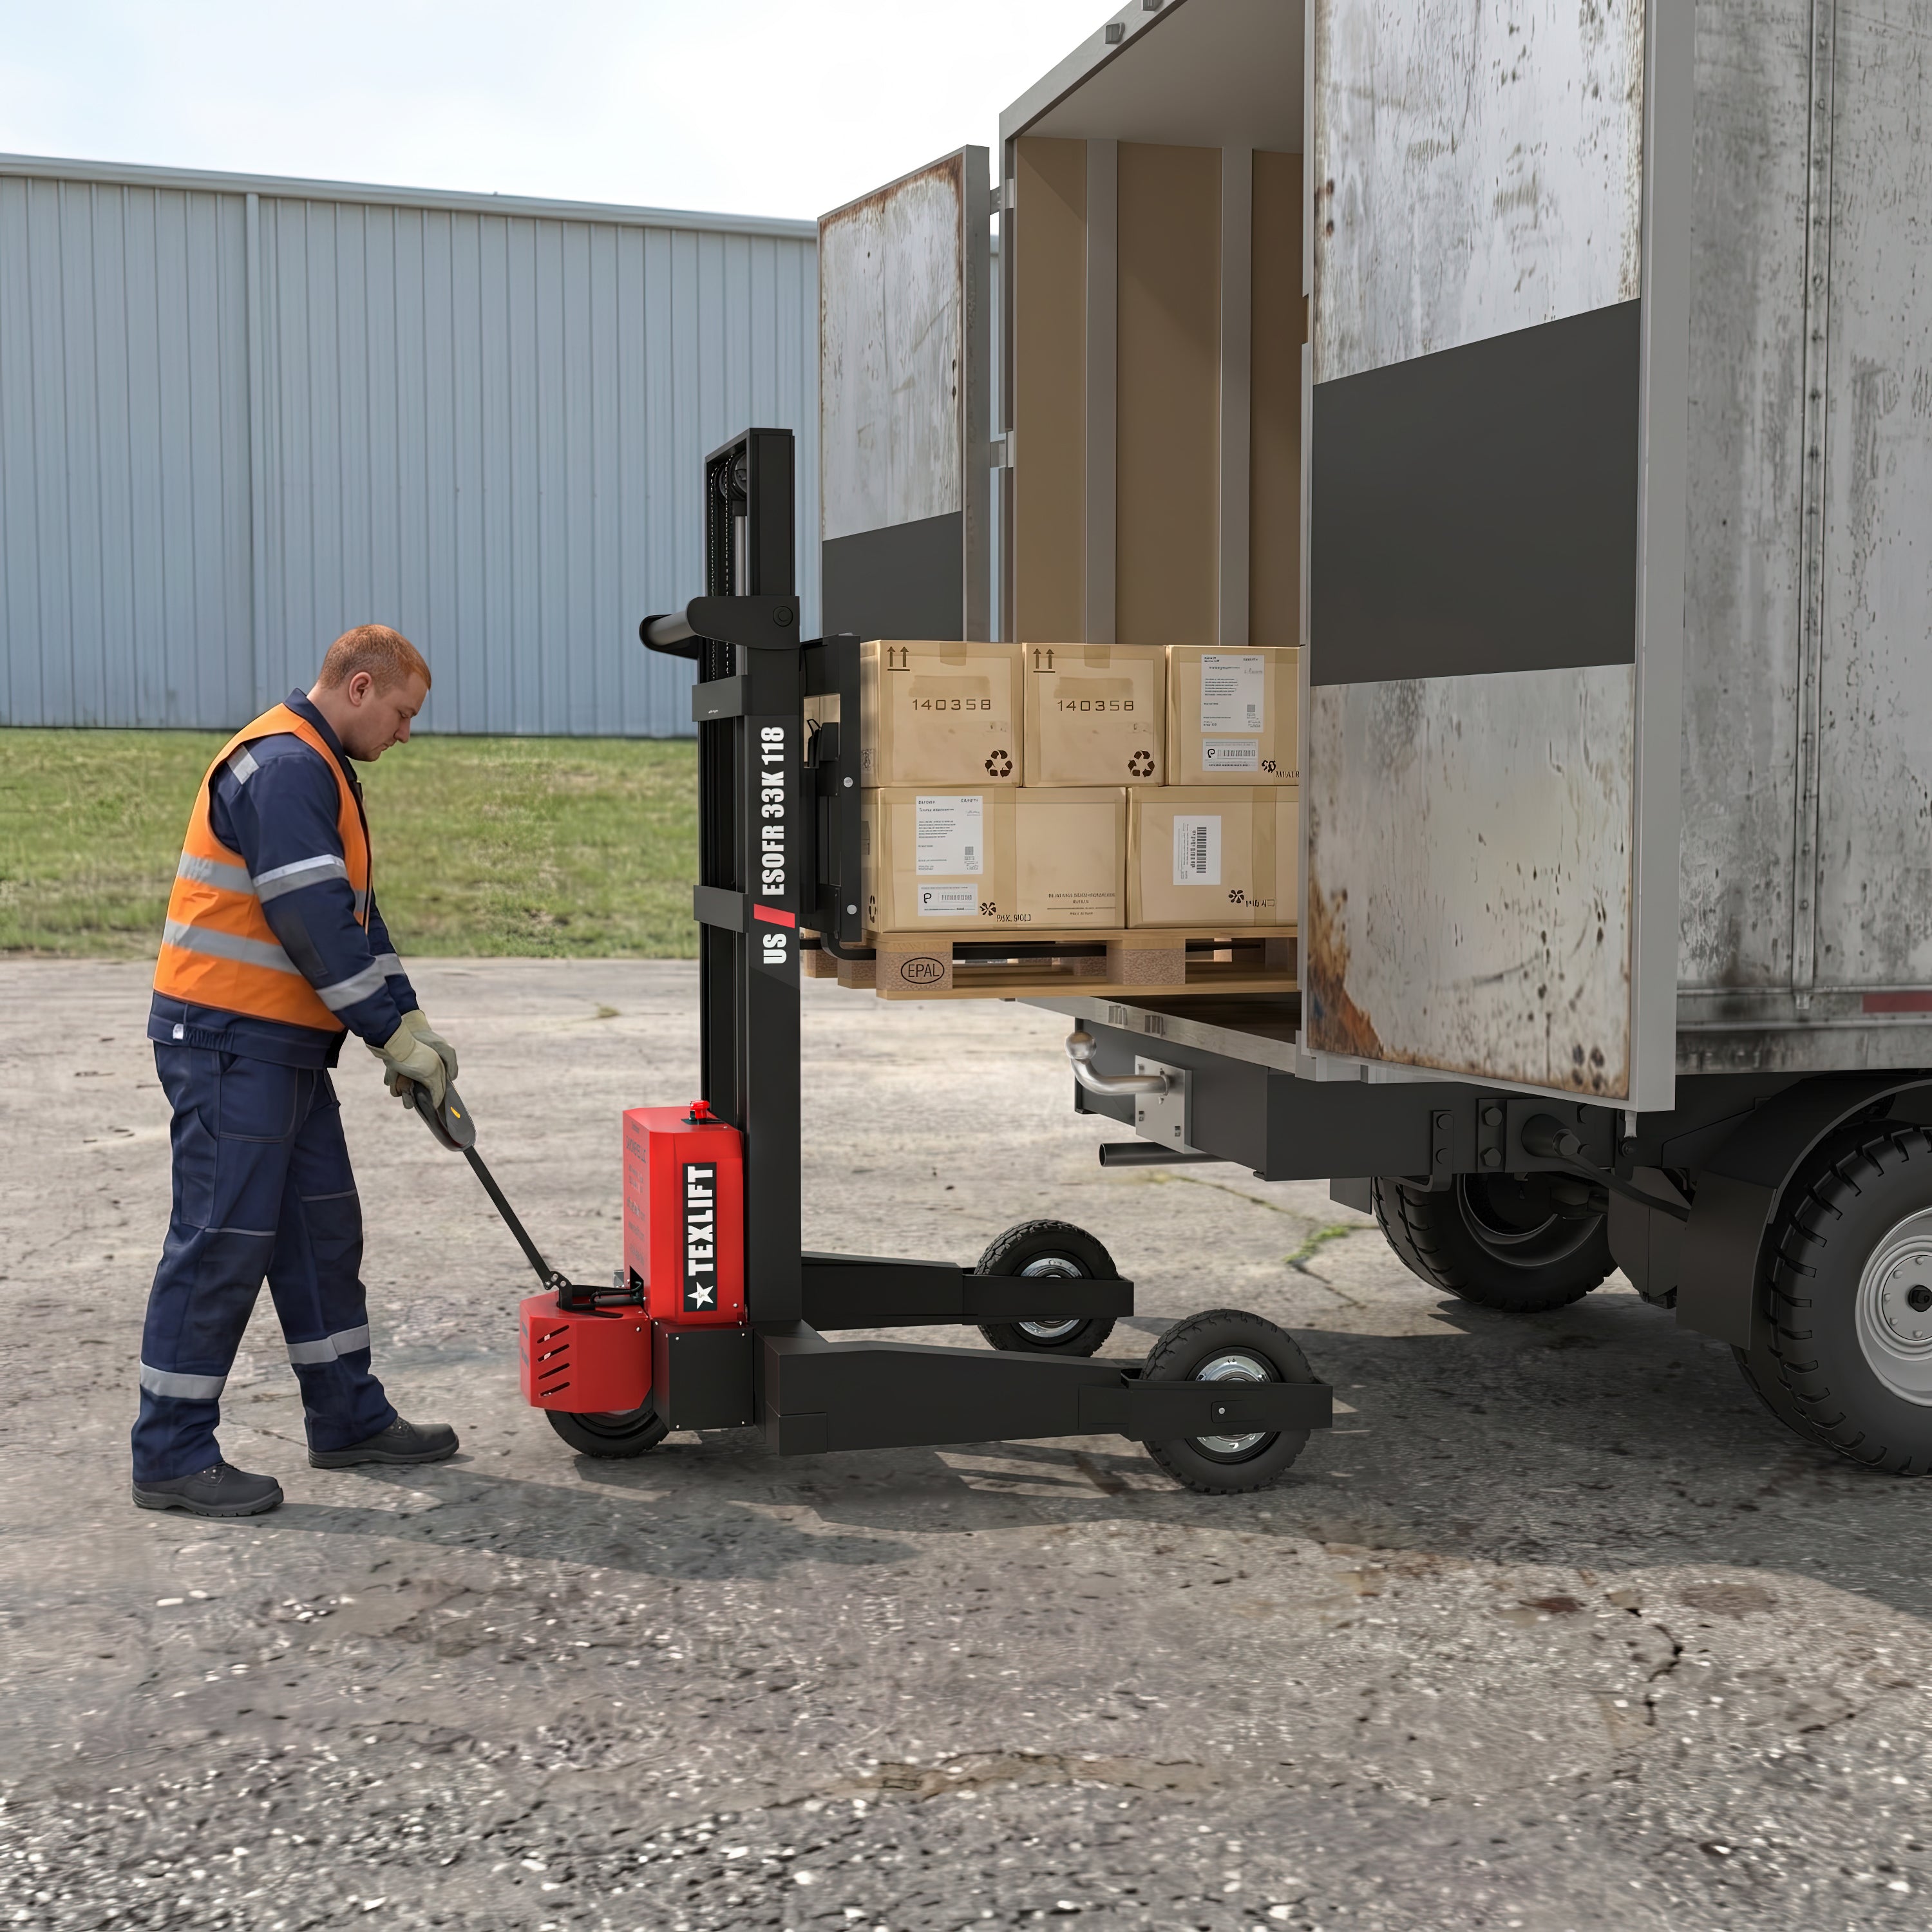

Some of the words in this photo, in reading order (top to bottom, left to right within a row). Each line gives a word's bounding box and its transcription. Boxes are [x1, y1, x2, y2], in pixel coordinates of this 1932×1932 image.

[913, 699, 991, 710] 140358
[1057, 700, 1134, 712] 140358
[761, 726, 784, 766] 118
[761, 771, 784, 819] 33K
[762, 825, 784, 895] ESOFR
[763, 933, 786, 964] US
[908, 963, 940, 977] EPAL
[687, 1166, 713, 1276] TEXLIFT
